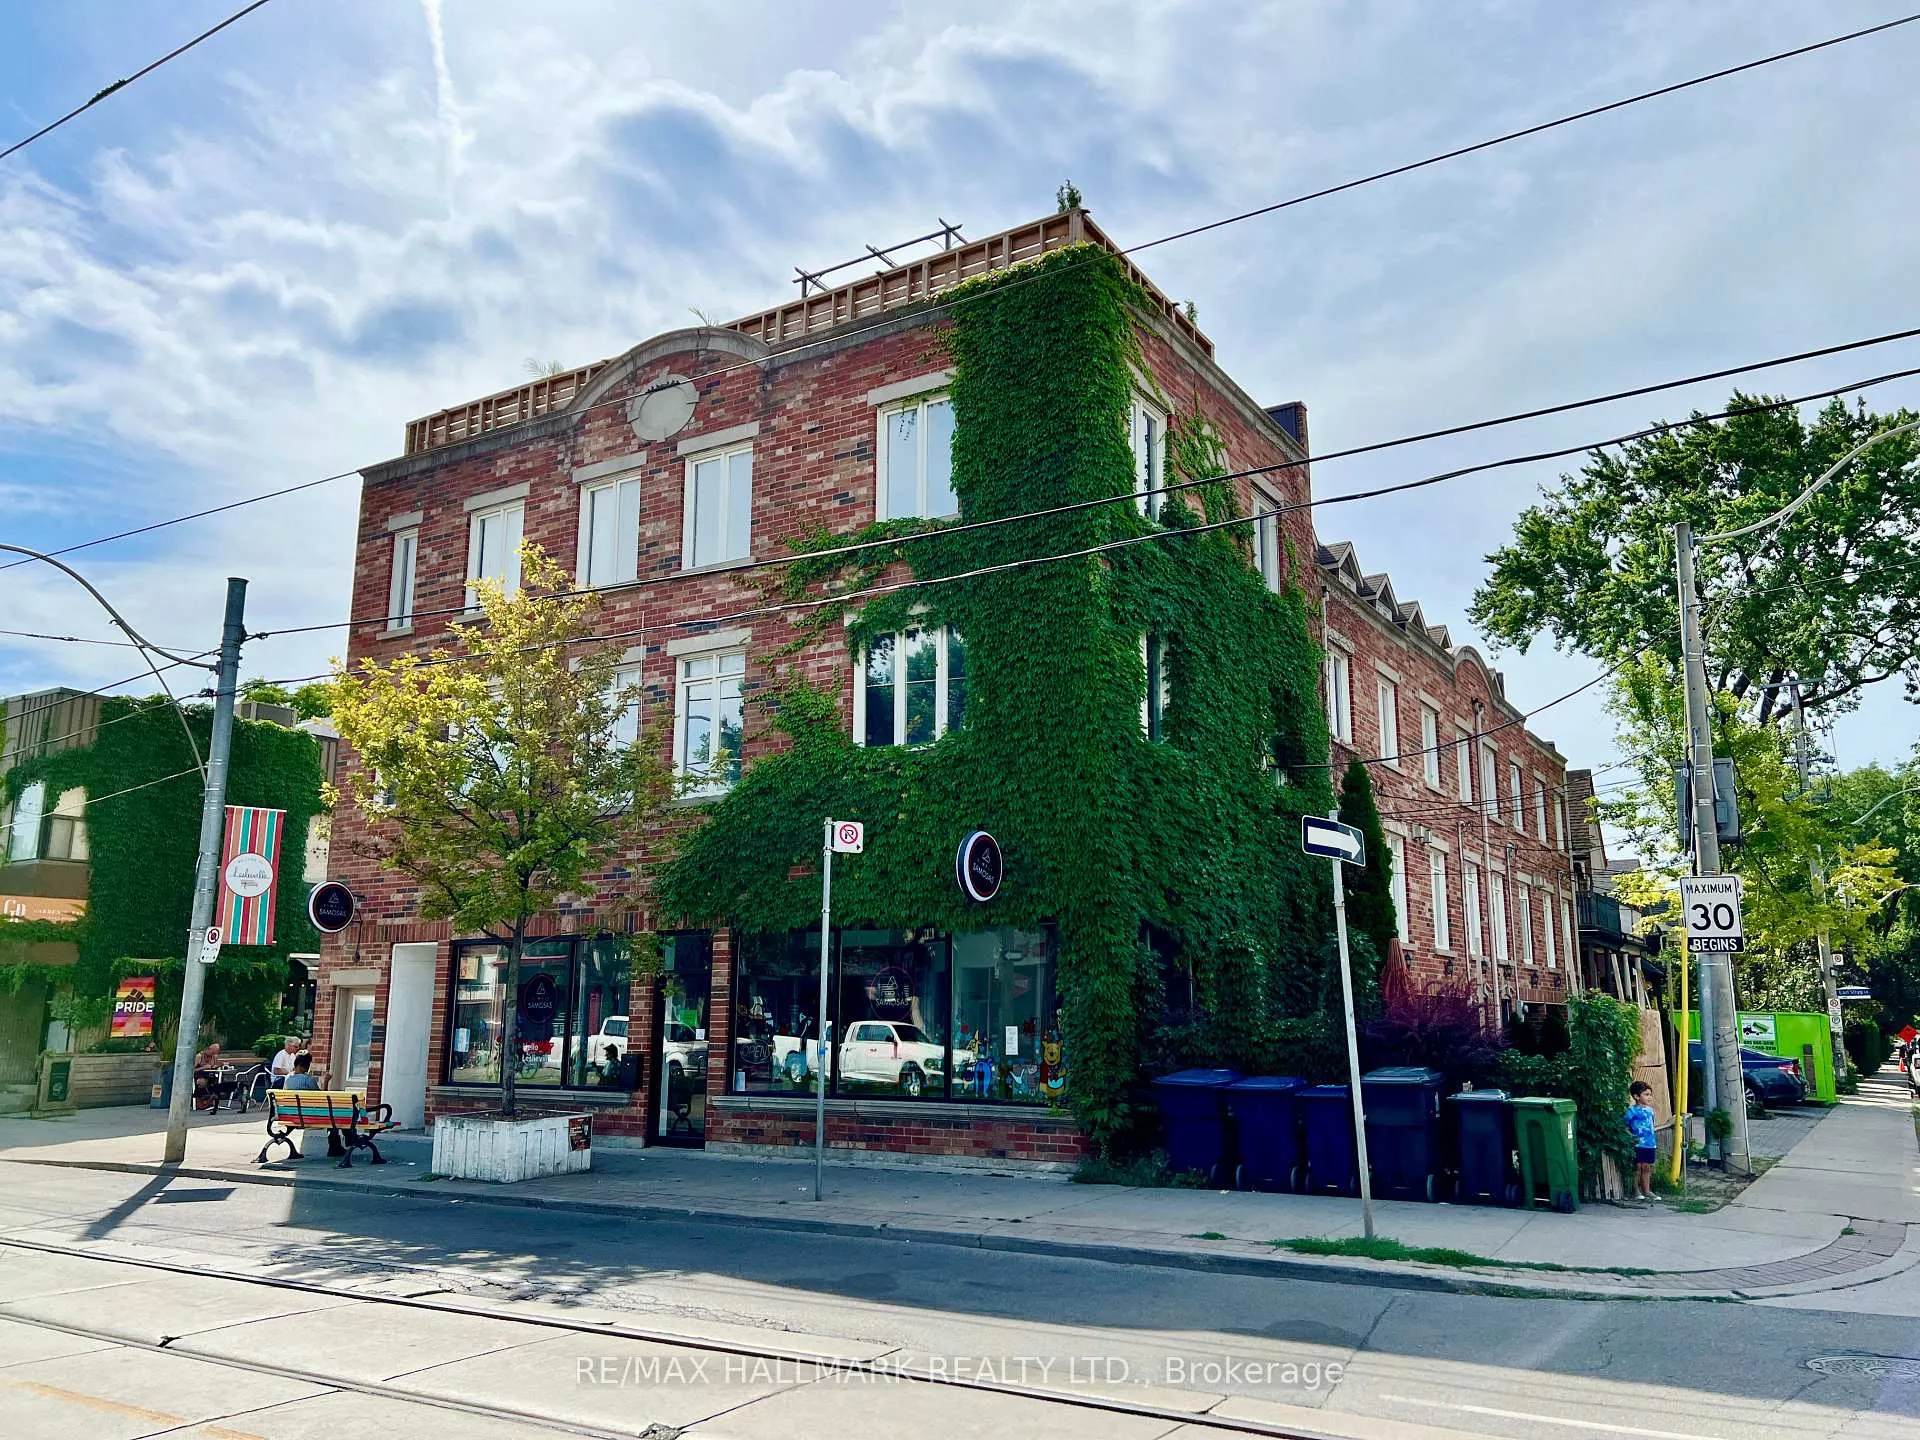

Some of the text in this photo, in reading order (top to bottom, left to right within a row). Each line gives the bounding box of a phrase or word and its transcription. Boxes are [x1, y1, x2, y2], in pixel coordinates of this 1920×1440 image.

[1686, 884, 1732, 894] MAXIMUM
[1691, 903, 1734, 931] 30
[1693, 938, 1738, 951] BEGINS
[115, 1001, 155, 1013] PRIDE
[527, 1001, 553, 1009] SAMOSAS
[875, 998, 909, 1007] SAMOSAS
[741, 1045, 767, 1058] OPEN
